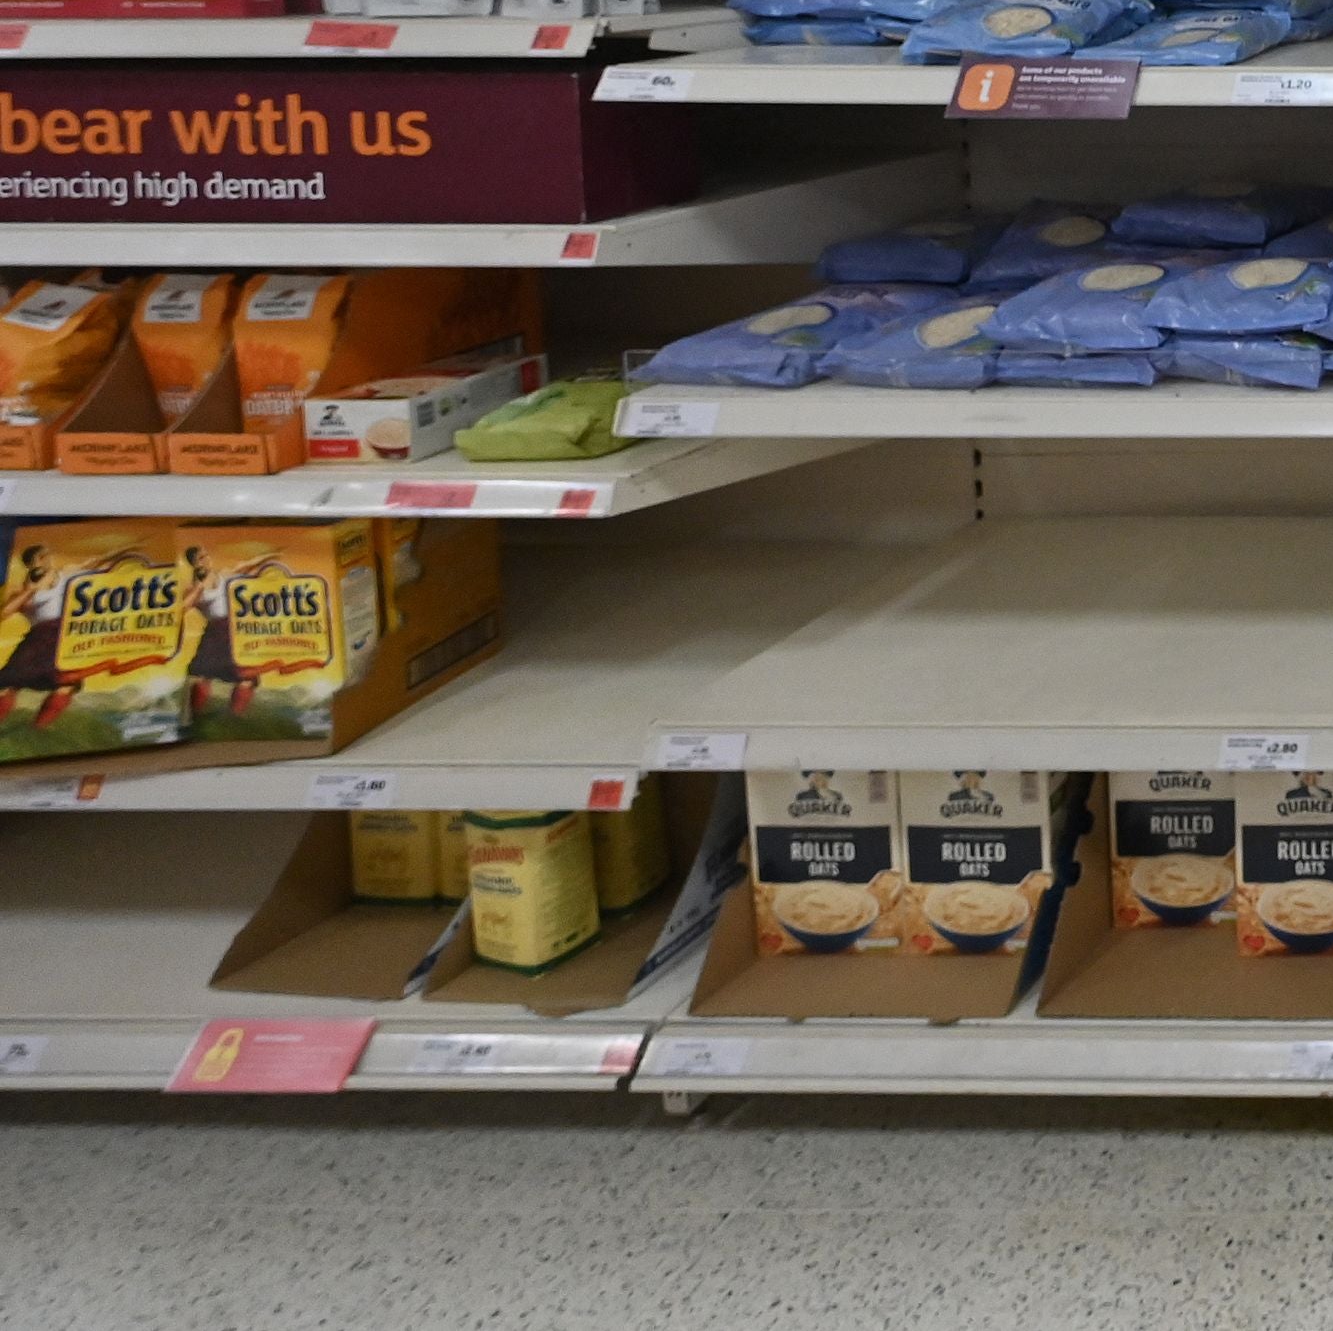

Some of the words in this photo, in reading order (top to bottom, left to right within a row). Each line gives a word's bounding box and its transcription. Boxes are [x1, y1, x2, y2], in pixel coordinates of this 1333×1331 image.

[0, 93, 151, 156] bear
[168, 93, 329, 156] with
[349, 109, 433, 156] us
[135, 173, 198, 206] high
[204, 173, 327, 201] demand
[71, 574, 178, 617] Scott's
[234, 583, 319, 618] Scott's
[1149, 774, 1212, 792] QUAKER
[787, 801, 853, 818] QUAKER
[939, 801, 1004, 818] QUAKER
[1150, 815, 1214, 835] ROLLED
[790, 842, 856, 862] ROLLED
[941, 842, 1007, 862] ROLLED
[1294, 860, 1326, 876] OATS
